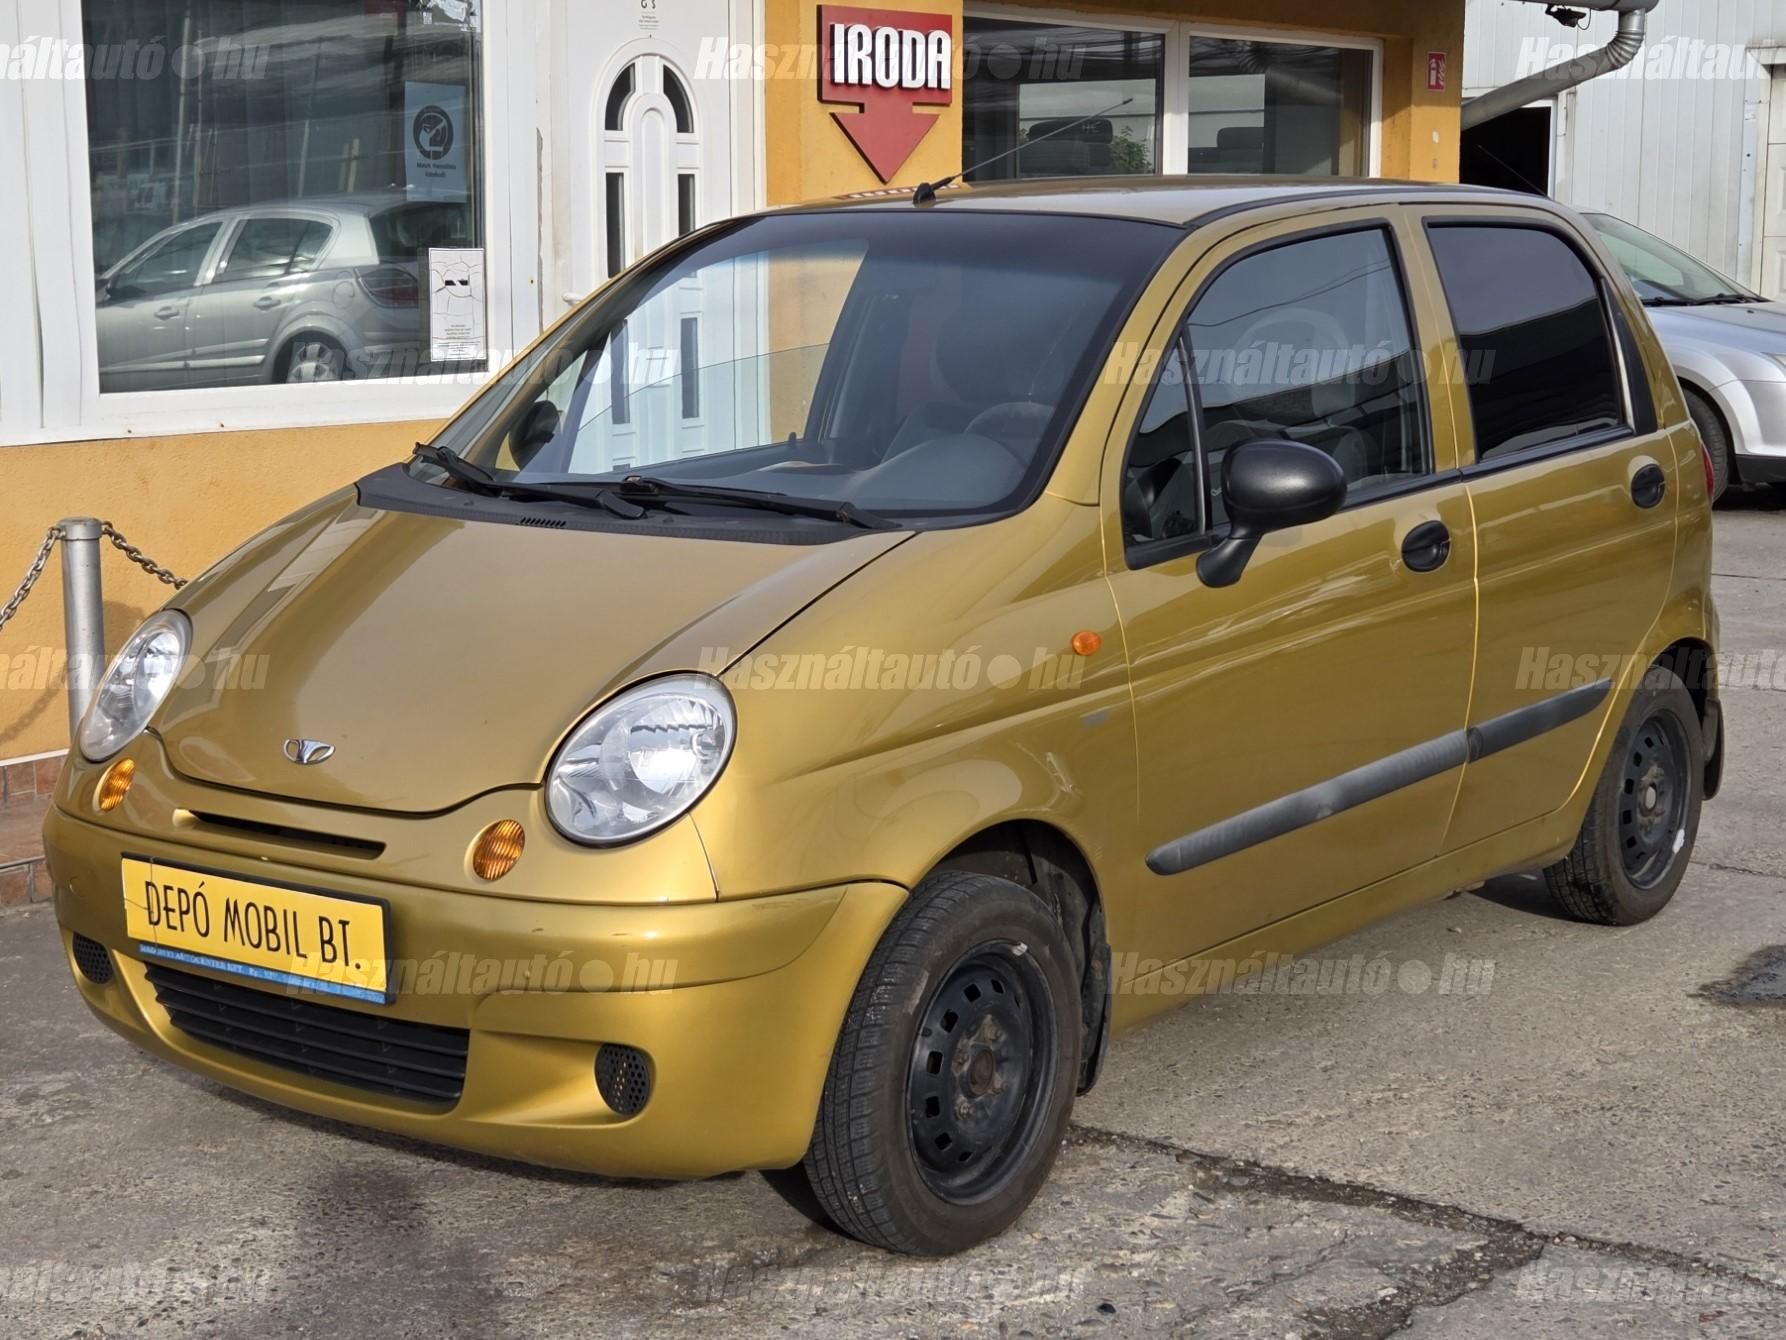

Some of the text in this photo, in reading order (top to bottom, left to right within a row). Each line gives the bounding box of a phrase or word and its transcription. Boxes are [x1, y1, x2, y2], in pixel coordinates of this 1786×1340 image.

[830, 23, 952, 90] IRODA
[145, 881, 361, 970] DEPÓ MOBIL BT.
